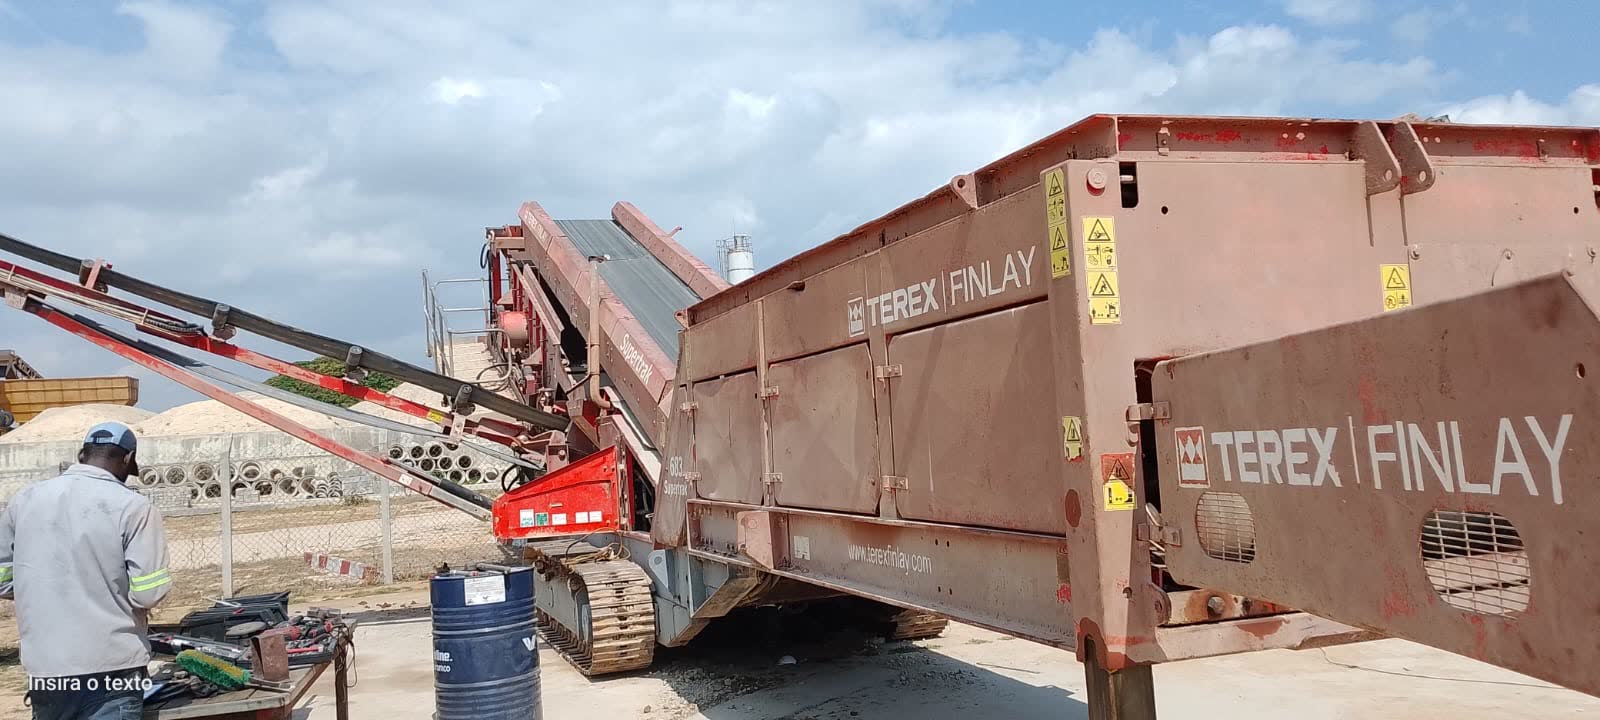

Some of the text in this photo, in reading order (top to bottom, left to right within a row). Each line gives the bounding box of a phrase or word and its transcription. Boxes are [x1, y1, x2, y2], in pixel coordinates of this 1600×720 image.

[867, 245, 1036, 327] TEREX FINLAY
[620, 333, 653, 385] Supertrak
[670, 456, 683, 477] 683
[1211, 414, 1573, 504] TEREX FINLAY
[848, 544, 932, 575] www.terexfinlaycom
